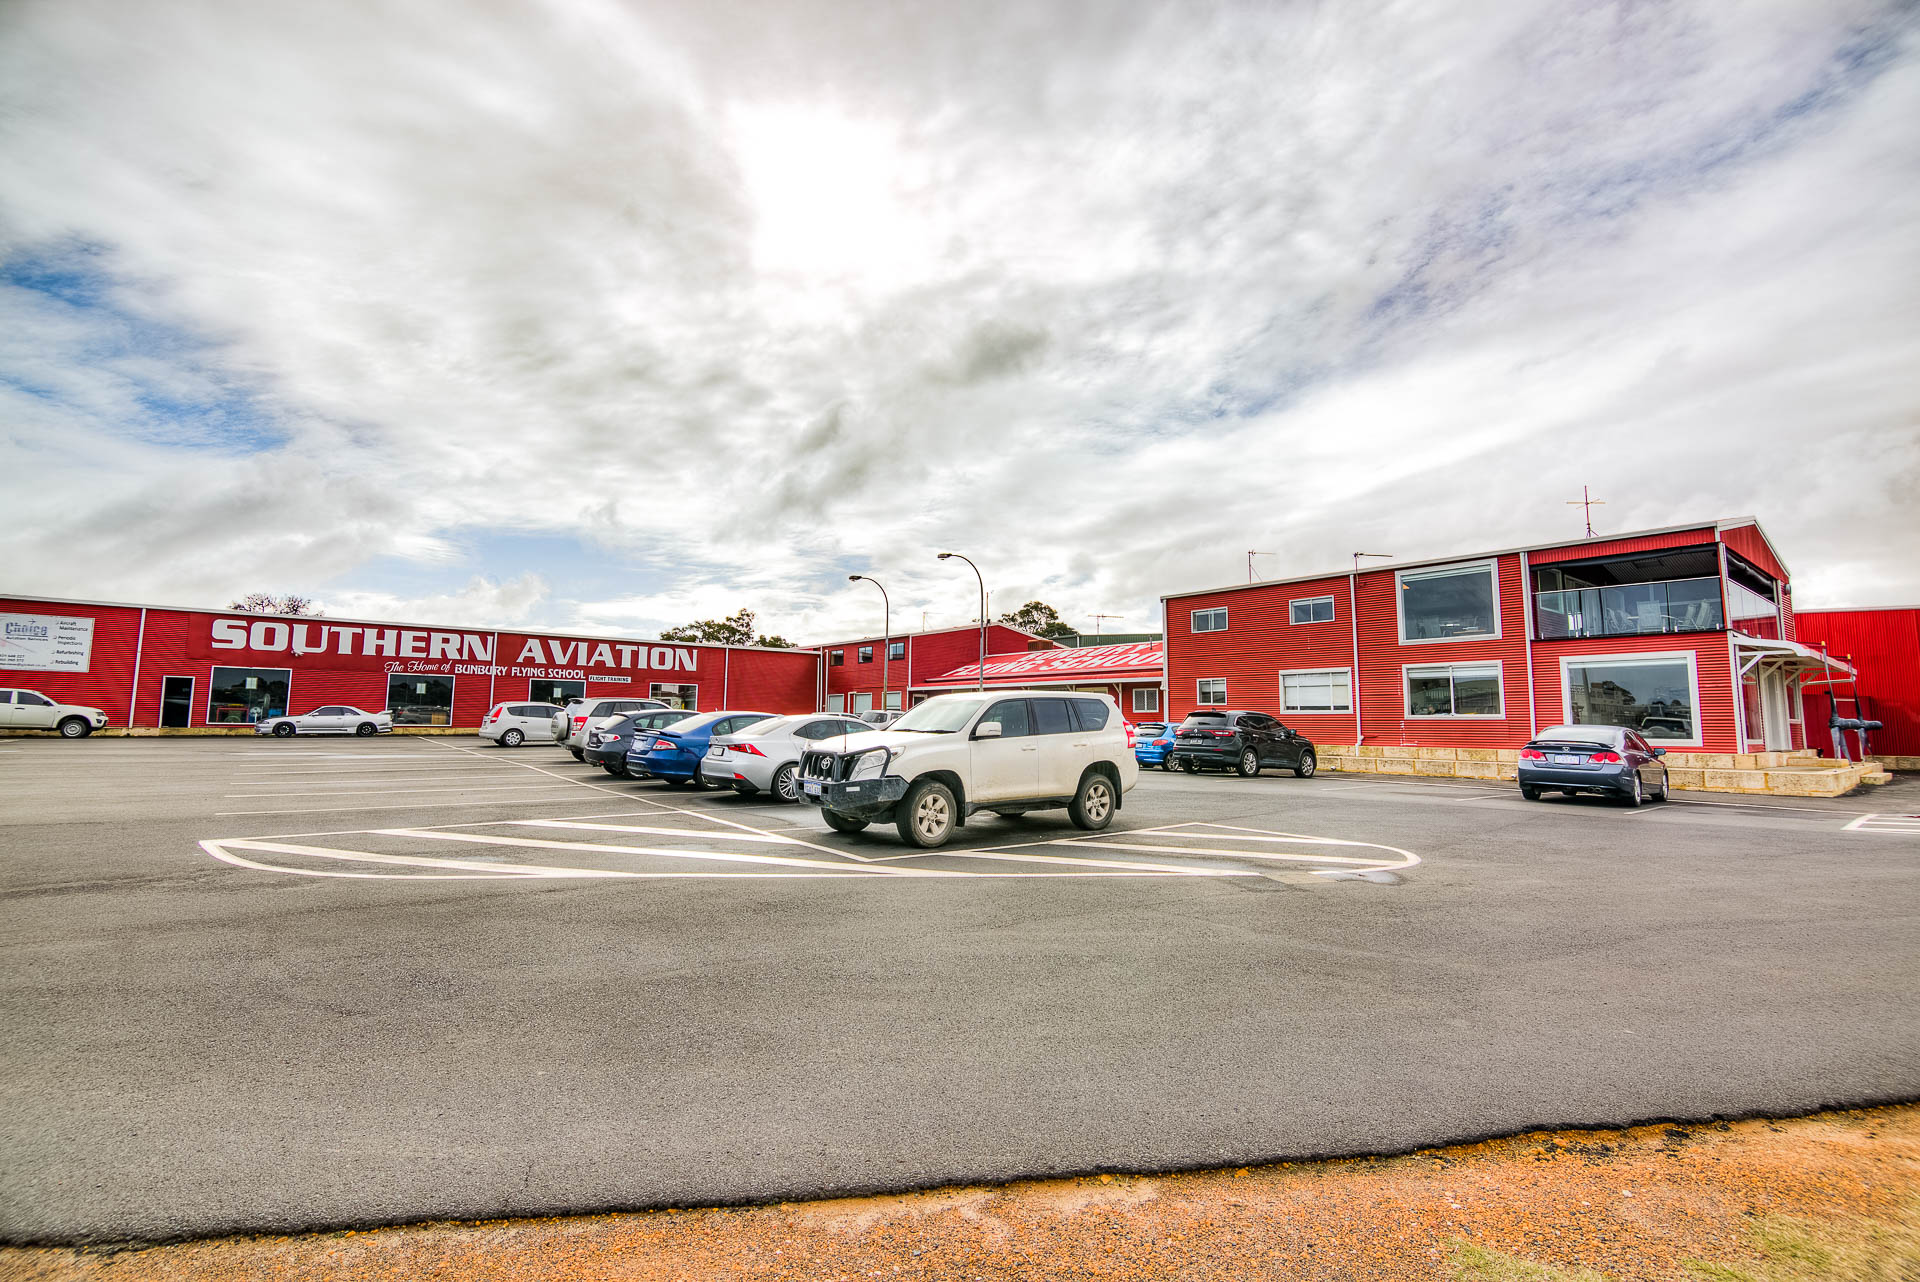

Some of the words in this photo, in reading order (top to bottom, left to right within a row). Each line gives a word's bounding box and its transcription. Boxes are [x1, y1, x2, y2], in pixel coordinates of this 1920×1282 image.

[211, 618, 493, 662] SOUTHERN
[516, 638, 698, 672] AVIATION
[1016, 643, 1158, 662] BUNBURY
[384, 661, 404, 673] The
[407, 660, 439, 673] Home
[440, 660, 453, 673] of
[455, 664, 507, 677] BUNBURY
[511, 666, 545, 678] FLYING
[548, 668, 586, 679] SCHOOL
[941, 660, 1045, 677] FLYING
